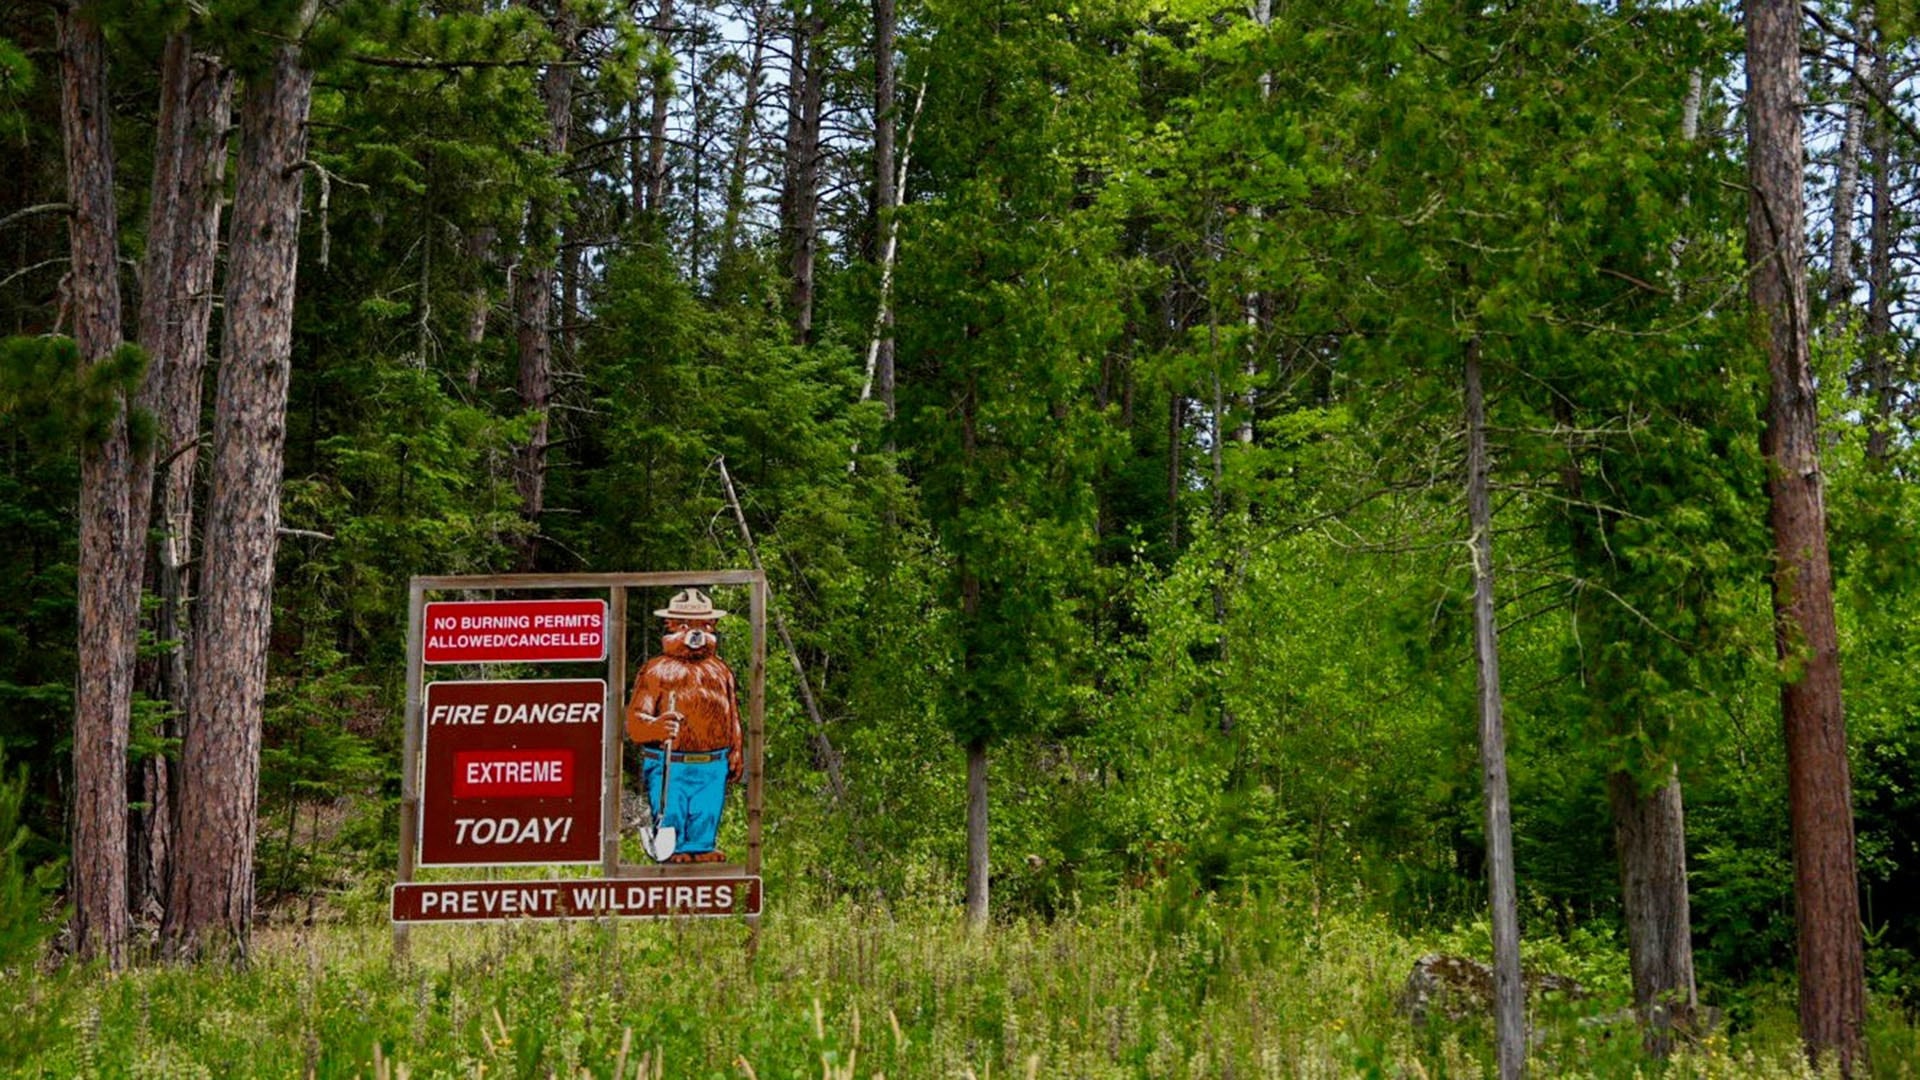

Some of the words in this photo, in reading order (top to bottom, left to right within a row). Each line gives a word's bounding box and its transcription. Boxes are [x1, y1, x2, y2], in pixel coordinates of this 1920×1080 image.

[434, 617, 456, 630] NO
[461, 616, 529, 629] BURNING
[534, 614, 600, 627] PERMITS
[428, 633, 600, 648] ALLOWED/CANCELLED
[431, 705, 488, 725] FIRE
[493, 703, 600, 724] DANGER
[467, 761, 563, 784] EXTREME
[455, 817, 573, 844] TODAY!
[421, 890, 557, 913] PREVENT
[572, 886, 733, 909] WILDFIRES
